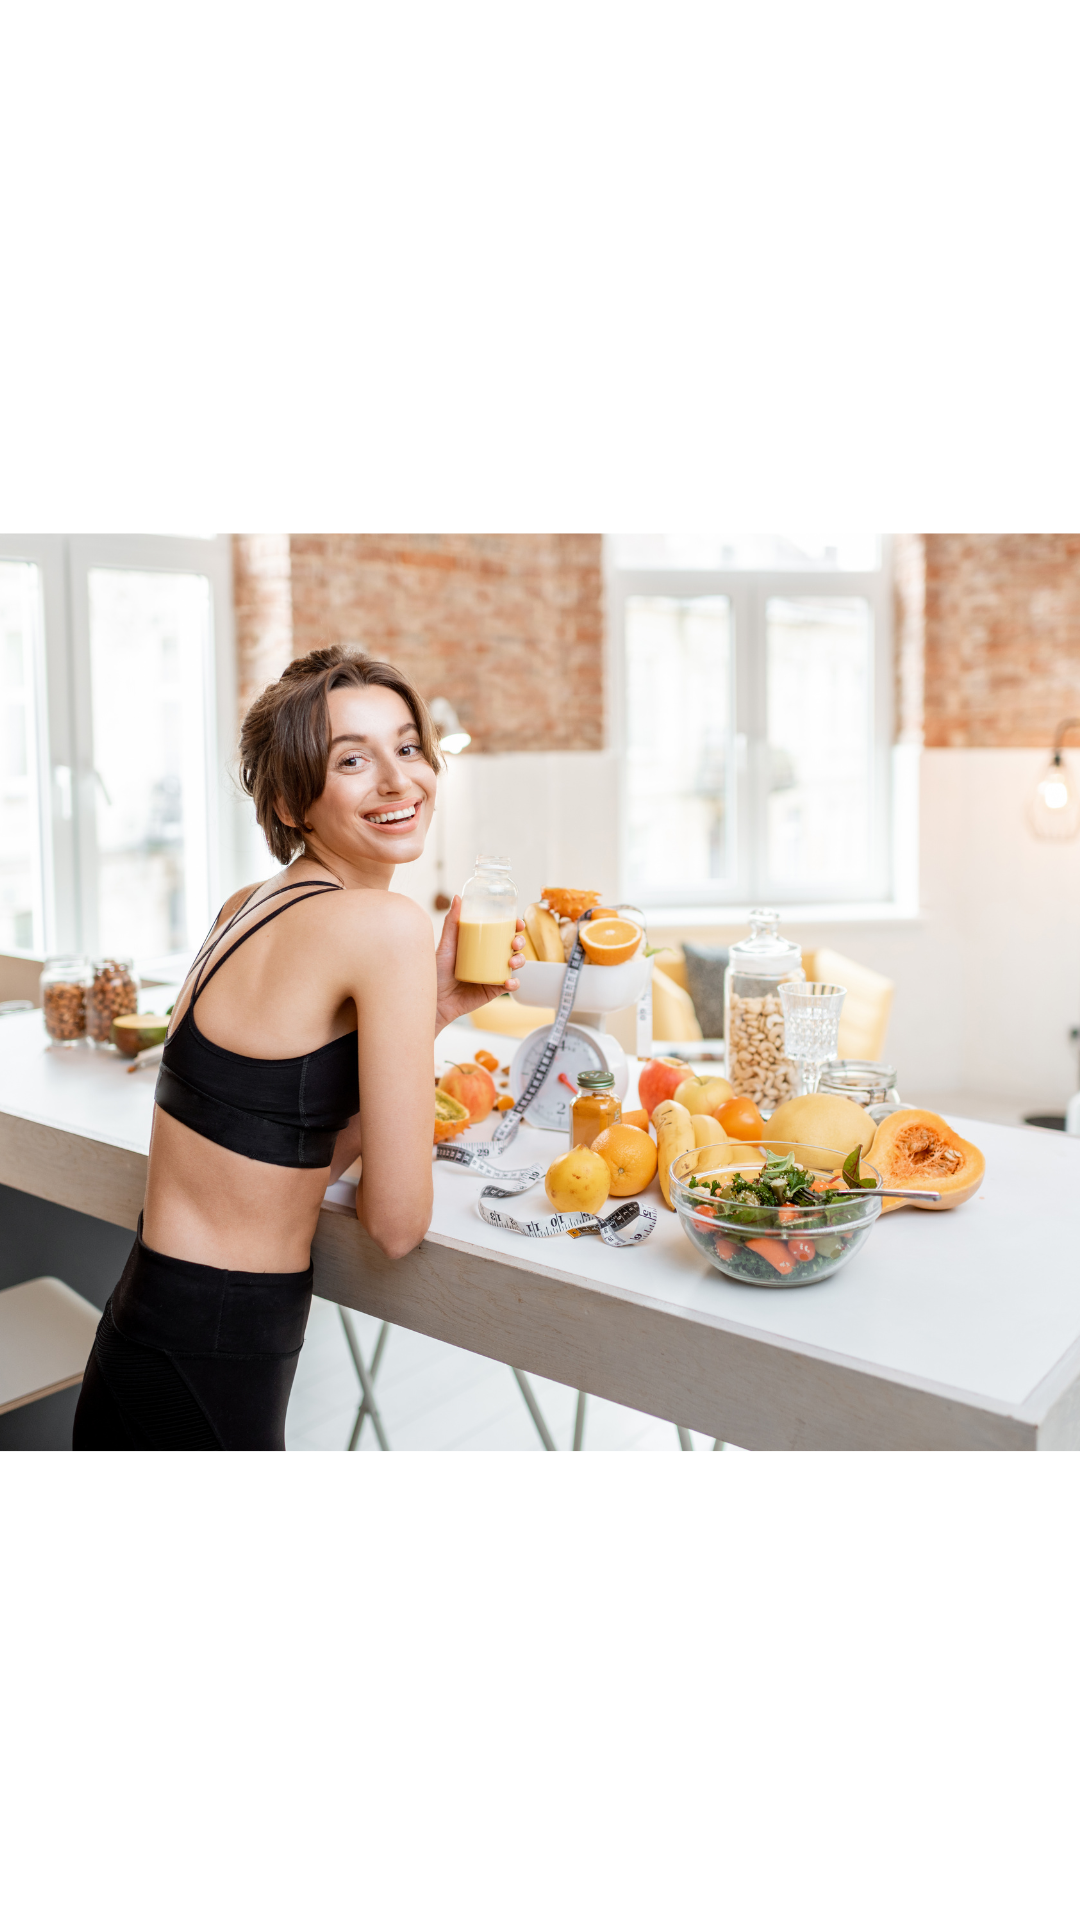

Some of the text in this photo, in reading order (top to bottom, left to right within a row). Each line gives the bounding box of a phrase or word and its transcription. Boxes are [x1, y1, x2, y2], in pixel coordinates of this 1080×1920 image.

[556, 1102, 566, 1114] 2
[476, 1148, 490, 1157] 29
[550, 1215, 565, 1227] 10
[526, 1222, 540, 1232] 11
